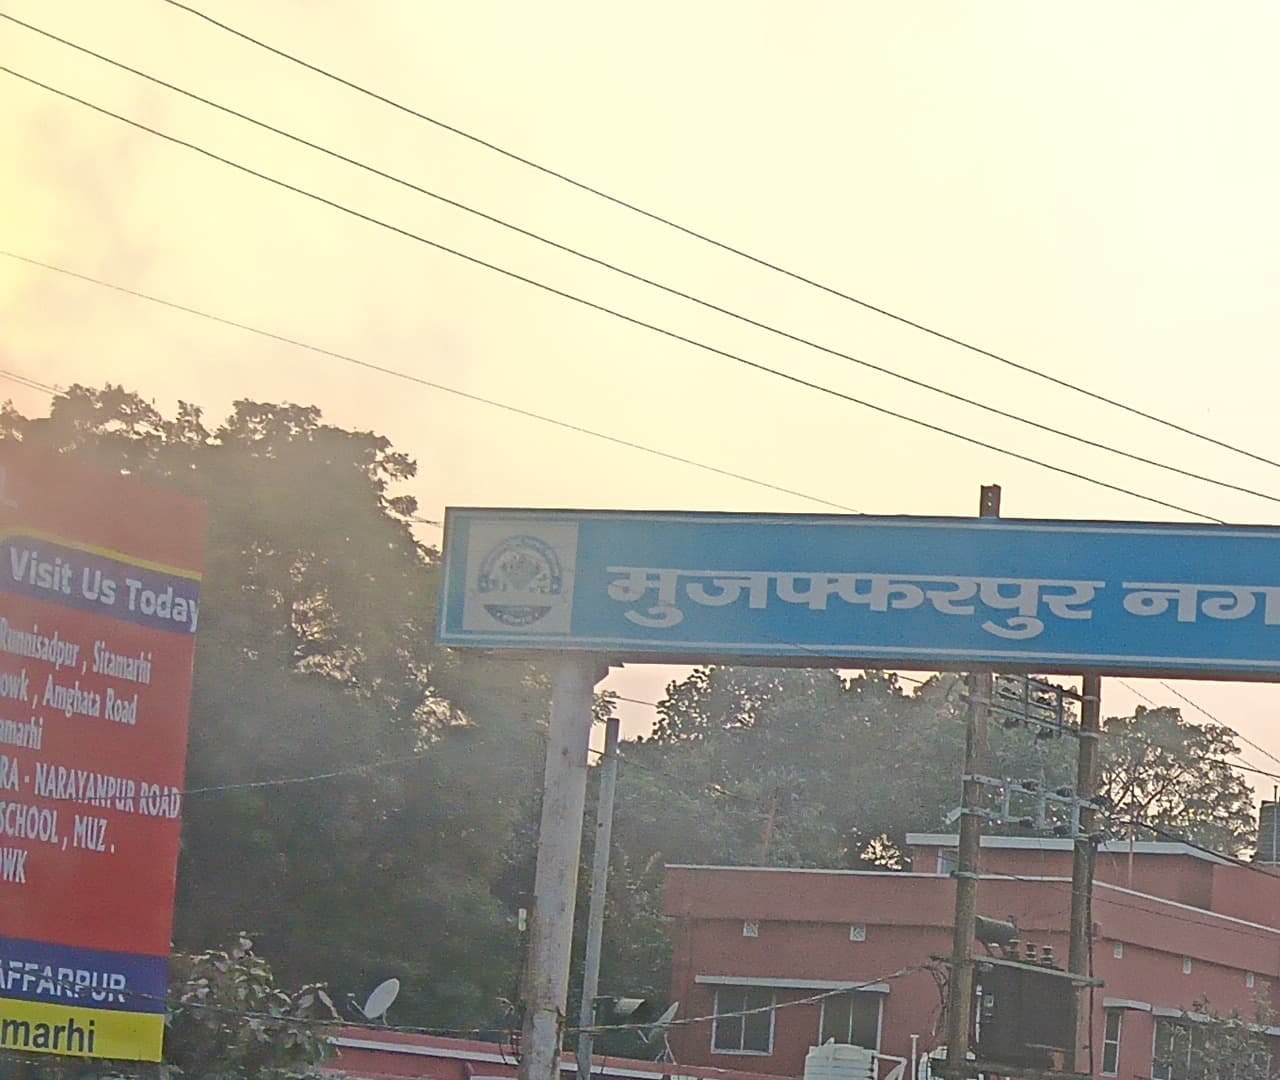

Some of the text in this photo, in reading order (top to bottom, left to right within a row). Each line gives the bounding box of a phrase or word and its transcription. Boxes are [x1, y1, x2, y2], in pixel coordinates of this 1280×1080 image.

[10, 547, 199, 633] Visit Us Today
[607, 565, 1105, 640] मुजफ्फरपुर
[93, 640, 152, 686] Sitamarhi
[105, 688, 139, 725] Road
[34, 762, 134, 813] NARAYANPUR
[0, 847, 28, 884] WK
[1, 1017, 95, 1053] marhi
